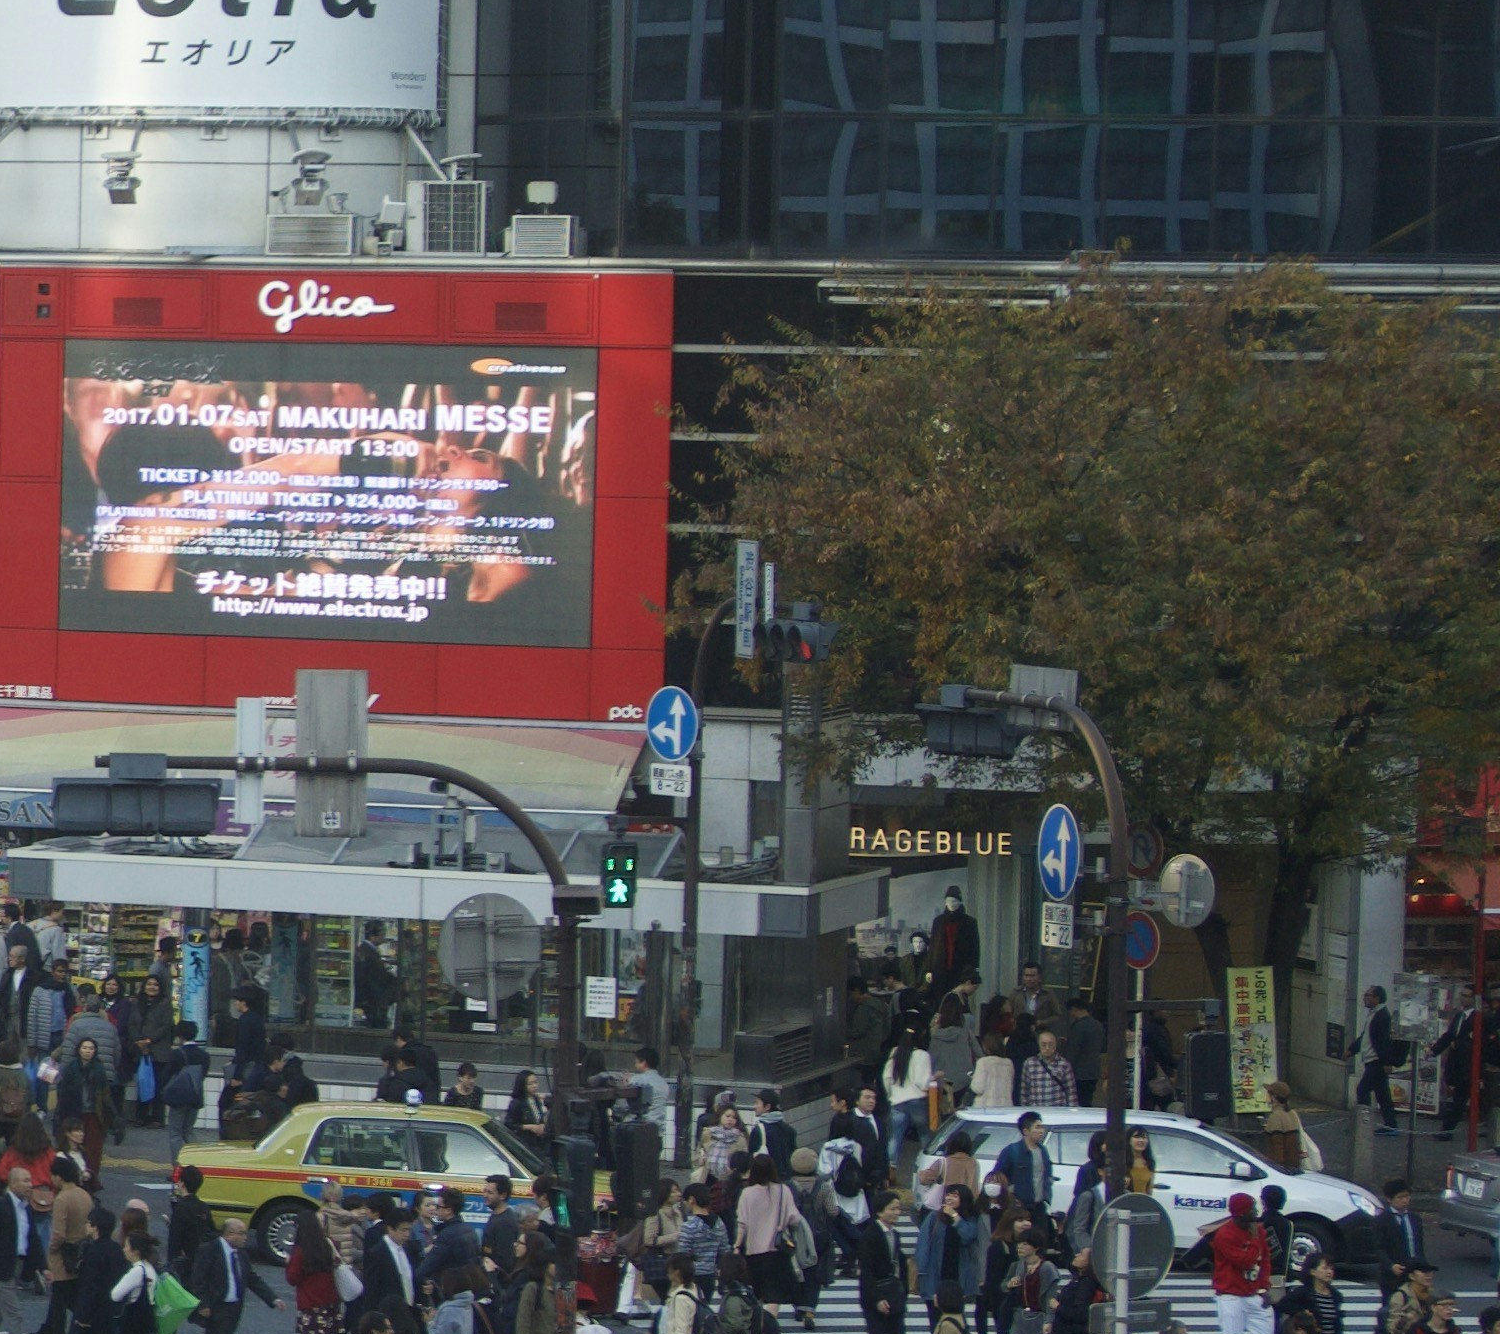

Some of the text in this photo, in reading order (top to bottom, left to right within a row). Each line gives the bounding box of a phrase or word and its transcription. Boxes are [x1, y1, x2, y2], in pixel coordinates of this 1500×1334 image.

[141, 39, 297, 67] エオリア
[257, 279, 394, 332] Glico
[486, 362, 567, 374] creativeman
[279, 406, 427, 432] MAKUHARI
[435, 405, 553, 434] MESSE
[228, 437, 420, 457] OPEN/START 13:00
[139, 467, 200, 484] TICKET
[183, 489, 269, 507] PLATINUM
[274, 492, 333, 509] TICKET
[212, 596, 430, 623] http://www.electrox.jp
[607, 704, 645, 722] pdc
[849, 825, 1013, 855] RAGEBLUE
